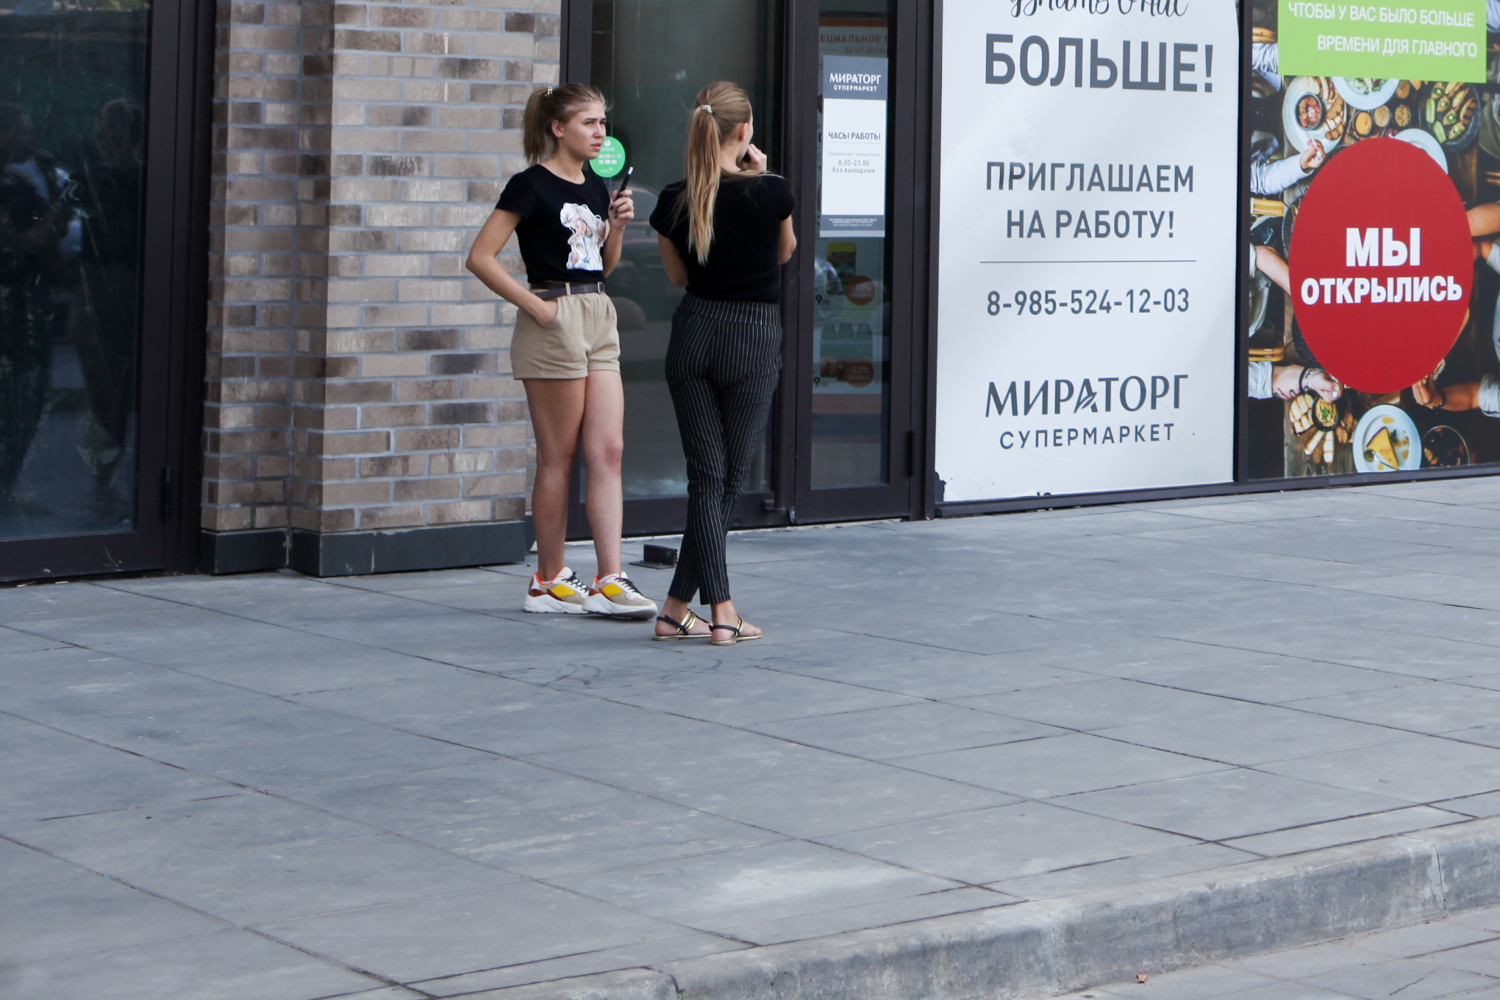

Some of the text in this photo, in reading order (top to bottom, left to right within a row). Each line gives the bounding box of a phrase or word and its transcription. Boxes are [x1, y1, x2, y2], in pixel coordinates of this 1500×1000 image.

[1288, 1, 1475, 28] ЧТОБЫ У ВАС БЫЛО БОЛЬШЕ
[1317, 34, 1478, 58] ВРЕМЕНИ ДЛЯ ГЛАВНОГО
[985, 33, 1213, 93] БОЛЬШЕ!
[829, 73, 881, 84] МИРАТОРГ
[828, 131, 881, 141] ЧАСЫ РАБОТЫ
[986, 161, 1194, 193] ПРИГЛАШАЕМ
[1006, 209, 1175, 238] НА РАБОТУ!
[1345, 227, 1421, 268] МЫ
[986, 288, 1190, 316] 8-985-524-12-03
[1301, 276, 1463, 305] ОТКРЫЛИСЬ
[985, 374, 1189, 418] МИРАТОРГ
[999, 423, 1175, 450] СУПЕРМАРКЕТ
